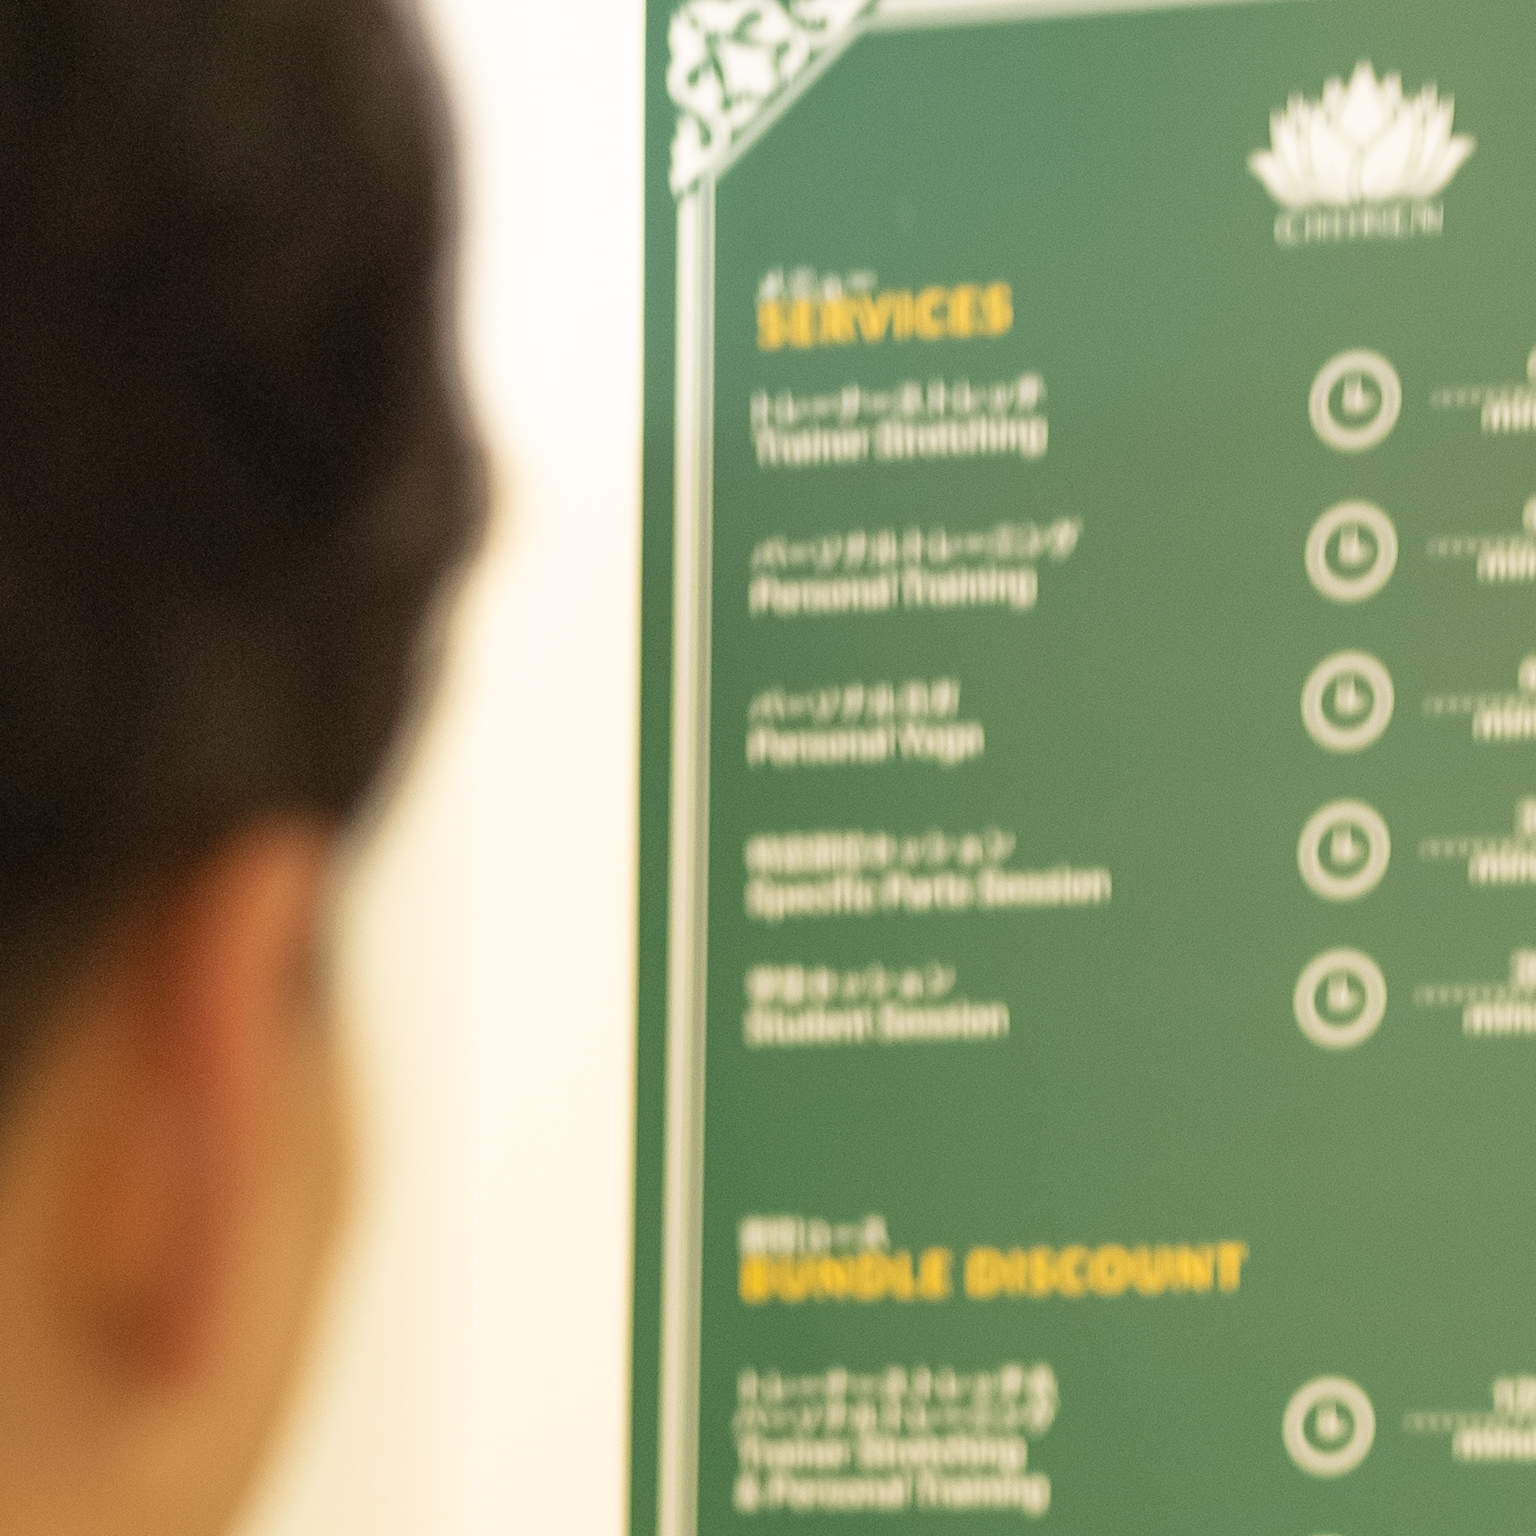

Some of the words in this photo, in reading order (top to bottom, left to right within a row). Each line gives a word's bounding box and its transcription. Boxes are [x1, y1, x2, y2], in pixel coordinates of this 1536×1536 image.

[757, 280, 1013, 348] SERVICES
[757, 422, 869, 466] Trainer
[875, 415, 1048, 459] Stretching
[750, 573, 897, 614] Personal
[901, 567, 1037, 610] Training
[747, 727, 895, 768] Personal
[900, 721, 984, 767] Yoga
[978, 864, 1111, 907] Session
[878, 999, 1010, 1041] Session
[739, 1247, 953, 1304] BUNDLE
[965, 1239, 1247, 1298] DISCOUNT
